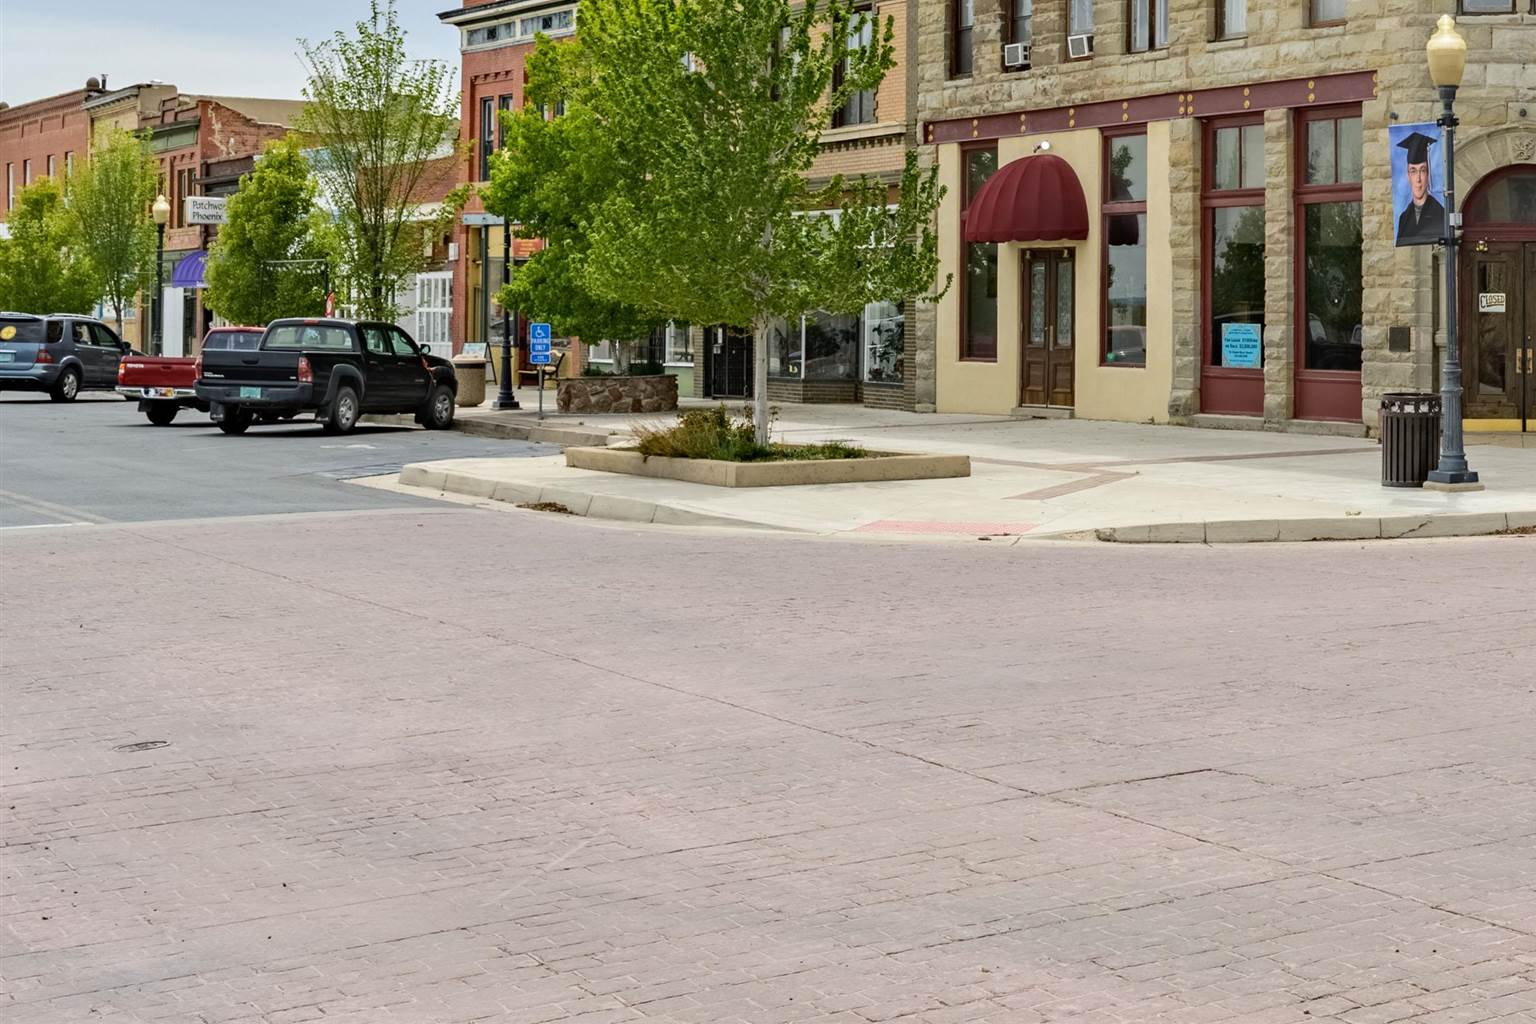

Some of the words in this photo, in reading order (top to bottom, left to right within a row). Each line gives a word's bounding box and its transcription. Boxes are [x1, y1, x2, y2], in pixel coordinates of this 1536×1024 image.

[192, 200, 225, 210] Patchwo
[192, 211, 224, 220] Phoenix
[1480, 294, 1504, 309] CLOSED
